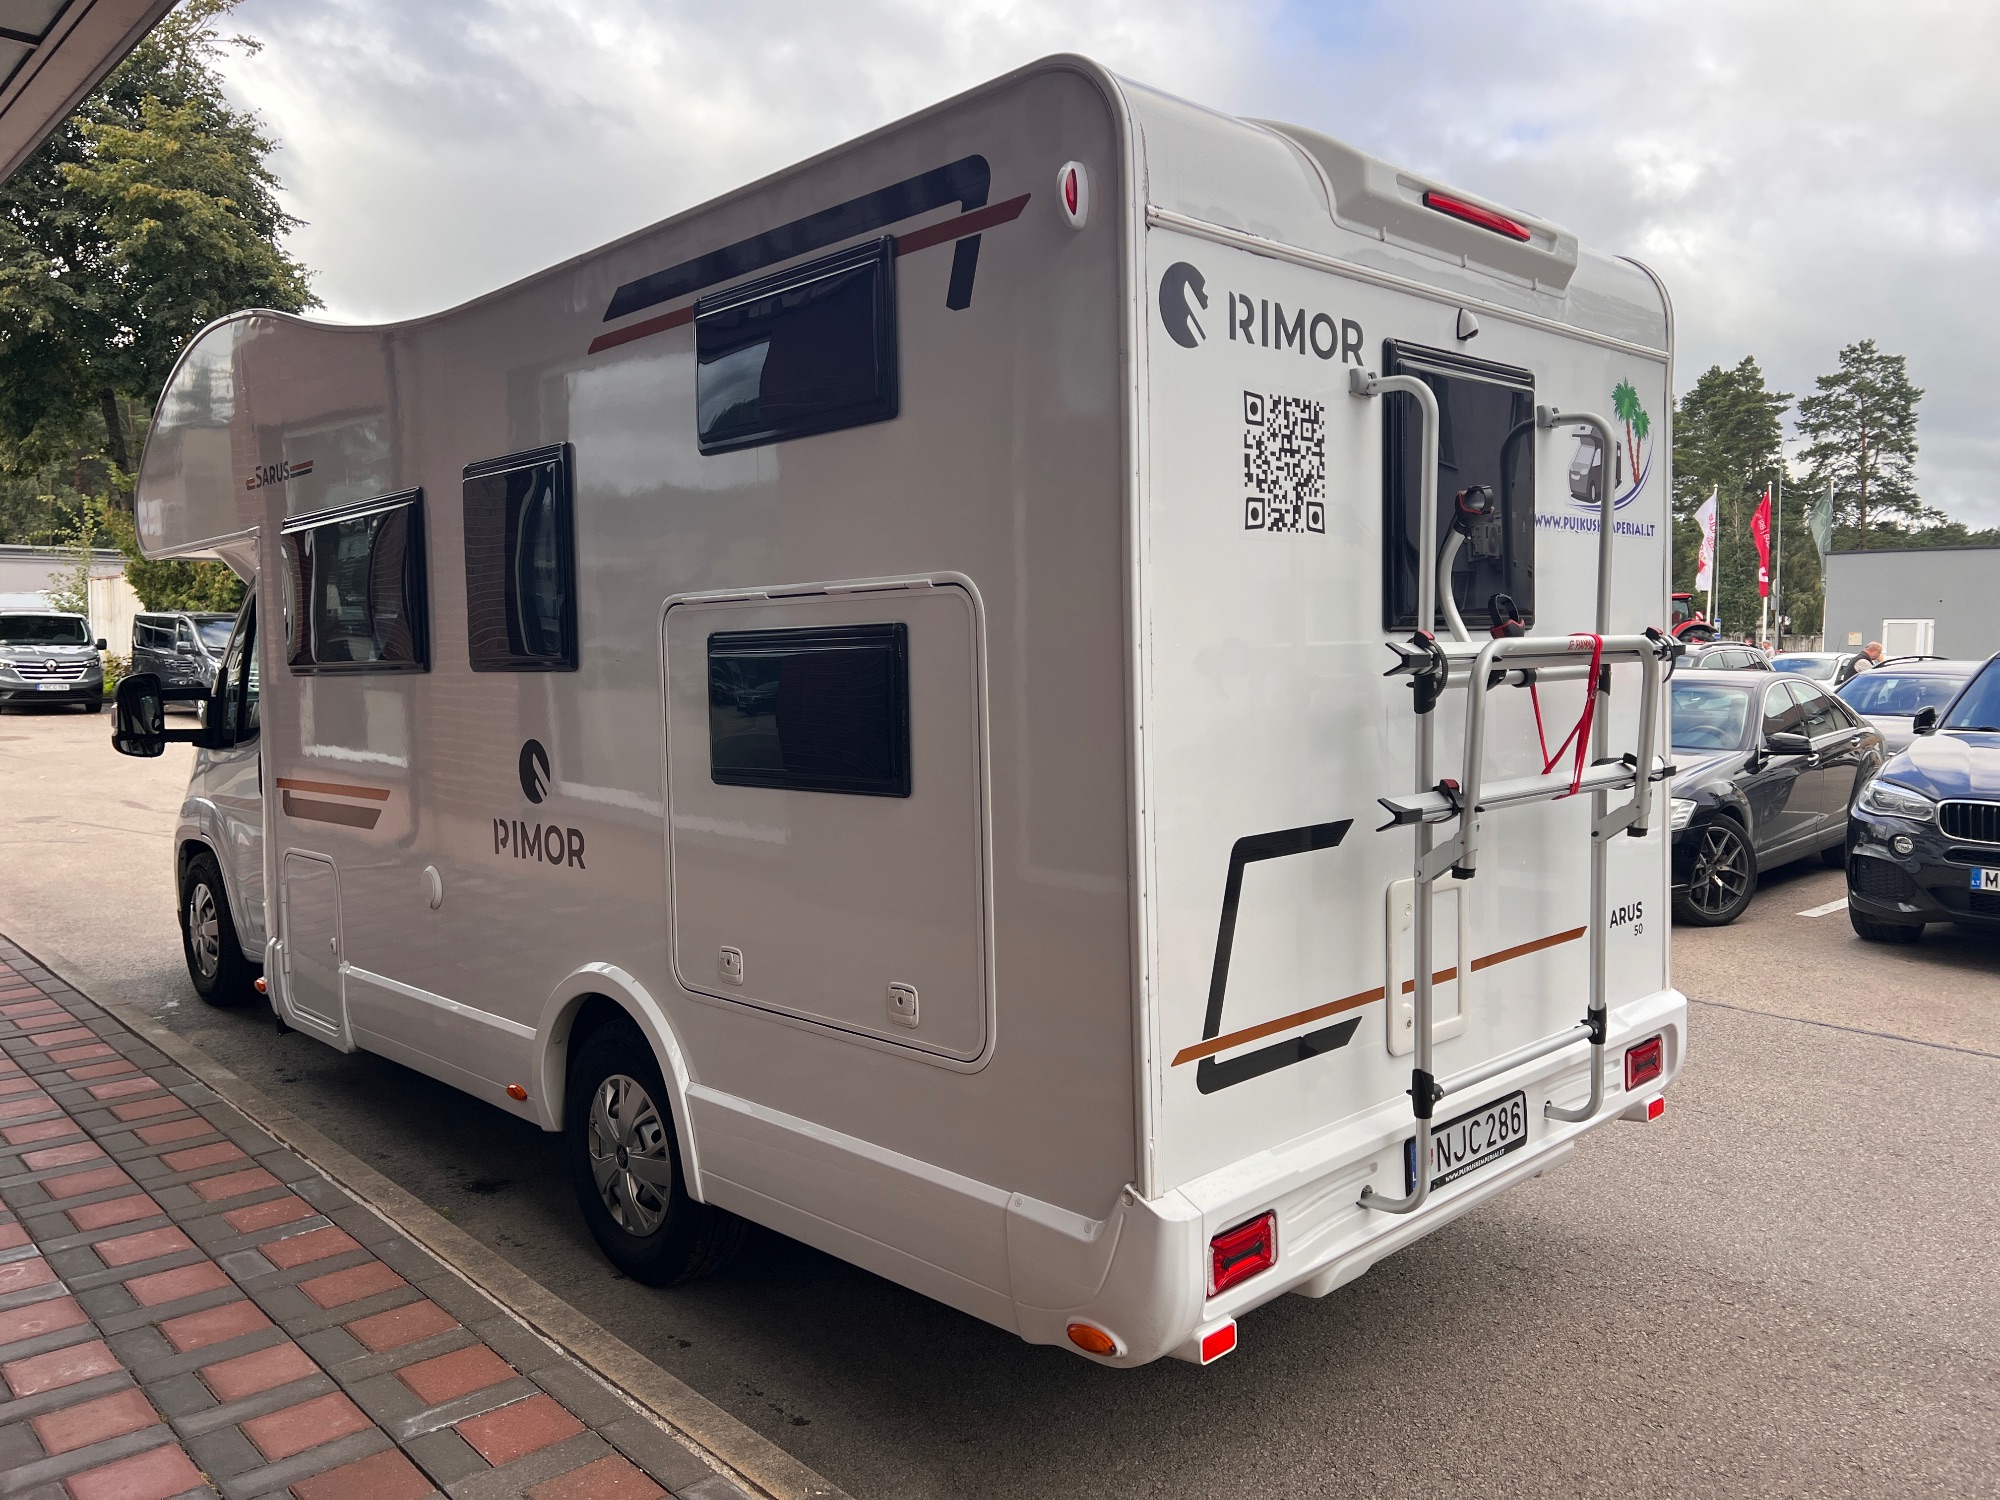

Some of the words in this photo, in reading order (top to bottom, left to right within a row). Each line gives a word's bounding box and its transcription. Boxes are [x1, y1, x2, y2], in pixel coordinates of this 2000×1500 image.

[1229, 291, 1364, 367] RIMOR
[255, 461, 290, 489] SARUS
[1535, 514, 1656, 537] WWW.PUIKUSPERIAI.LT
[1609, 901, 1643, 929] ARUS
[1634, 923, 1643, 936] 50
[1436, 1101, 1521, 1172] NJC286
